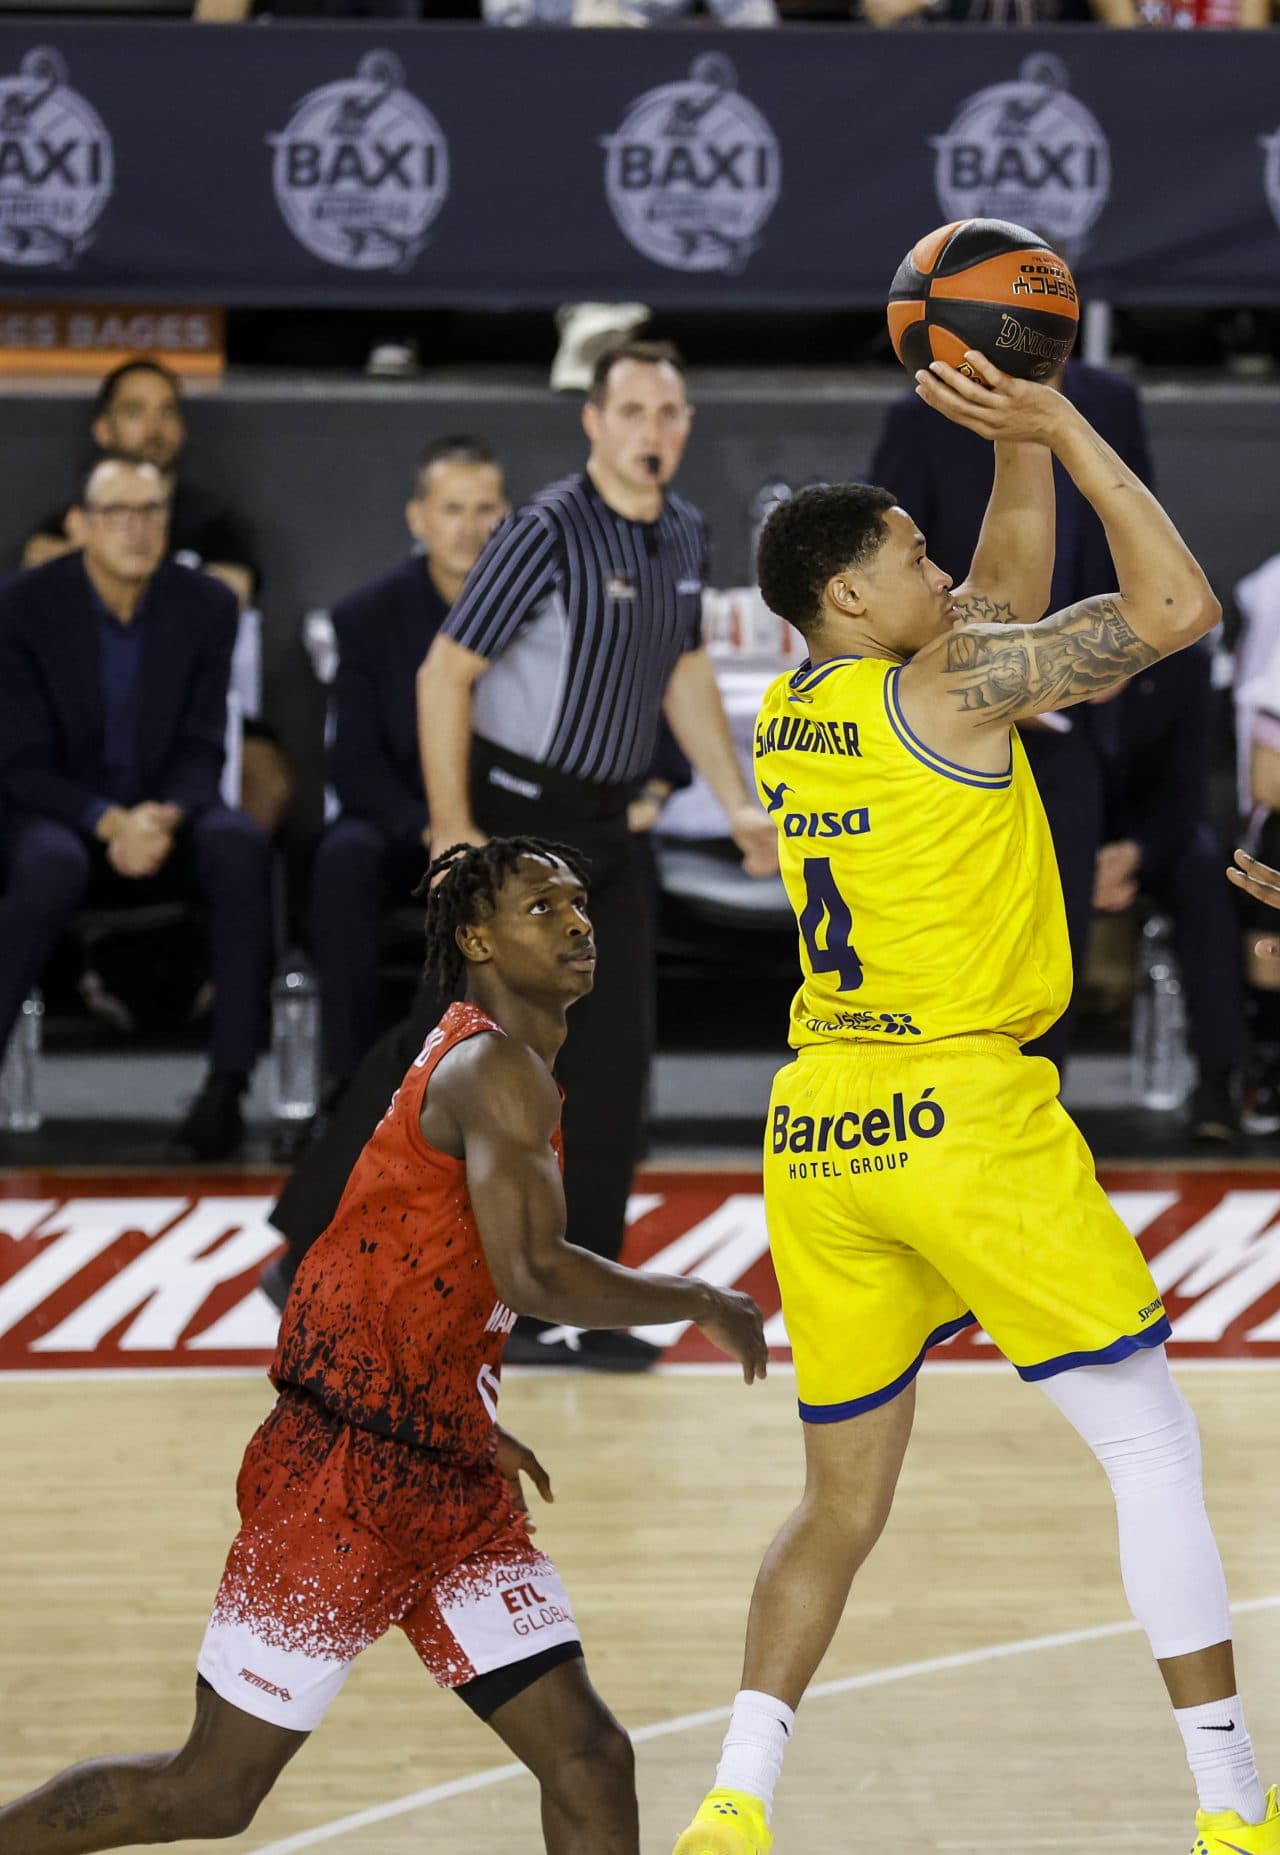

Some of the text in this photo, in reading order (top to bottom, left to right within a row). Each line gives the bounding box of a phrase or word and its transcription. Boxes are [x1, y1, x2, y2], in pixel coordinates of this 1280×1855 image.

[0, 141, 101, 186] AXI
[286, 141, 437, 188] BAXI
[618, 143, 768, 191] BAXI
[949, 143, 1098, 191] BAXI
[800, 857, 864, 992] 4
[773, 1087, 945, 1154] Barceló
[789, 1151, 908, 1180] HOTEL GROUP
[501, 1582, 547, 1615] ETL
